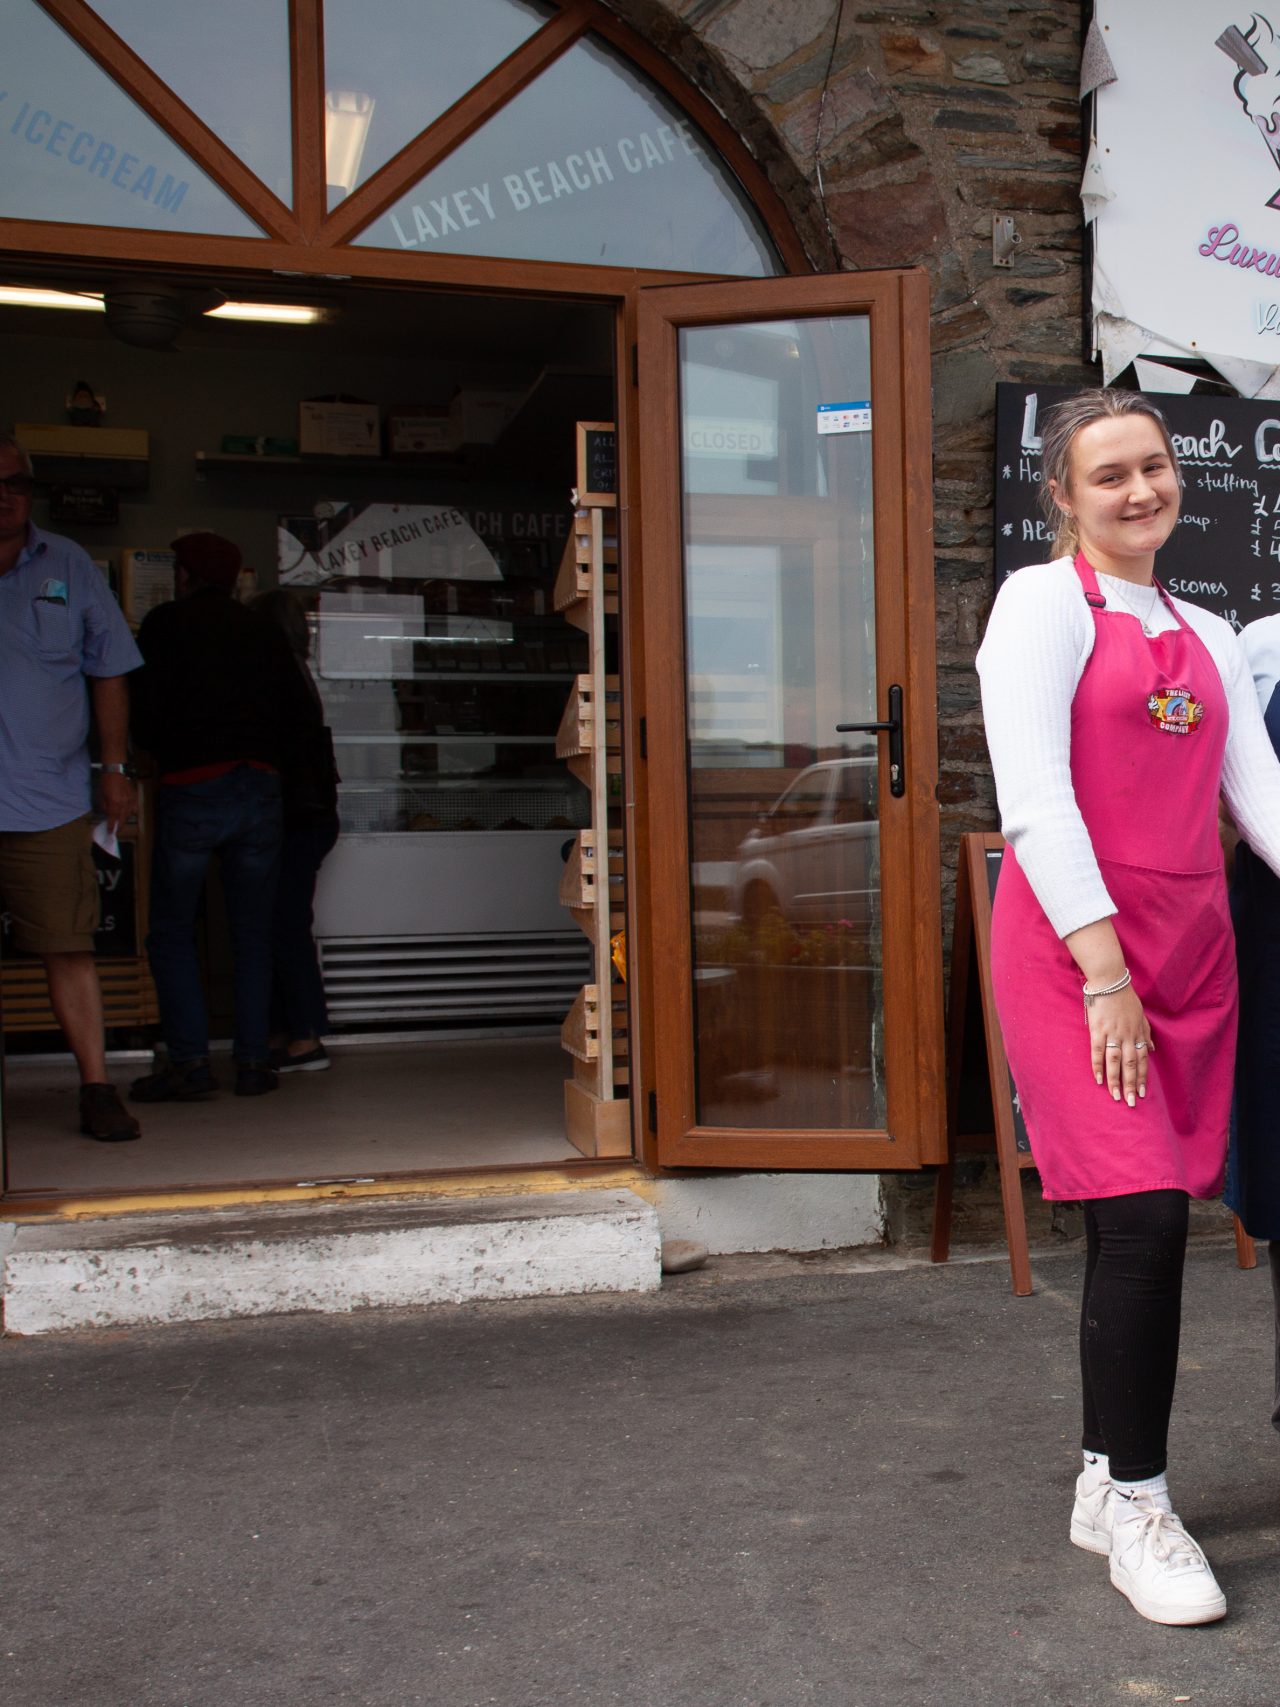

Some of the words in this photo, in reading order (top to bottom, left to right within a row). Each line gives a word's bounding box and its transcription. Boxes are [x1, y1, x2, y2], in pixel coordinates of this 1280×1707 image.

[10, 102, 190, 214] ICECREAM
[390, 183, 496, 248] LAXEY
[503, 146, 614, 213] BEACH
[617, 119, 701, 174] CAFE
[690, 431, 761, 450] CLOSED
[1197, 472, 1258, 498] stuffing
[371, 521, 421, 553] BEACH
[423, 508, 462, 535] CAFE
[512, 511, 566, 539] CAFE
[1168, 578, 1228, 597] scones
[1160, 721, 1189, 734] COMPANY
